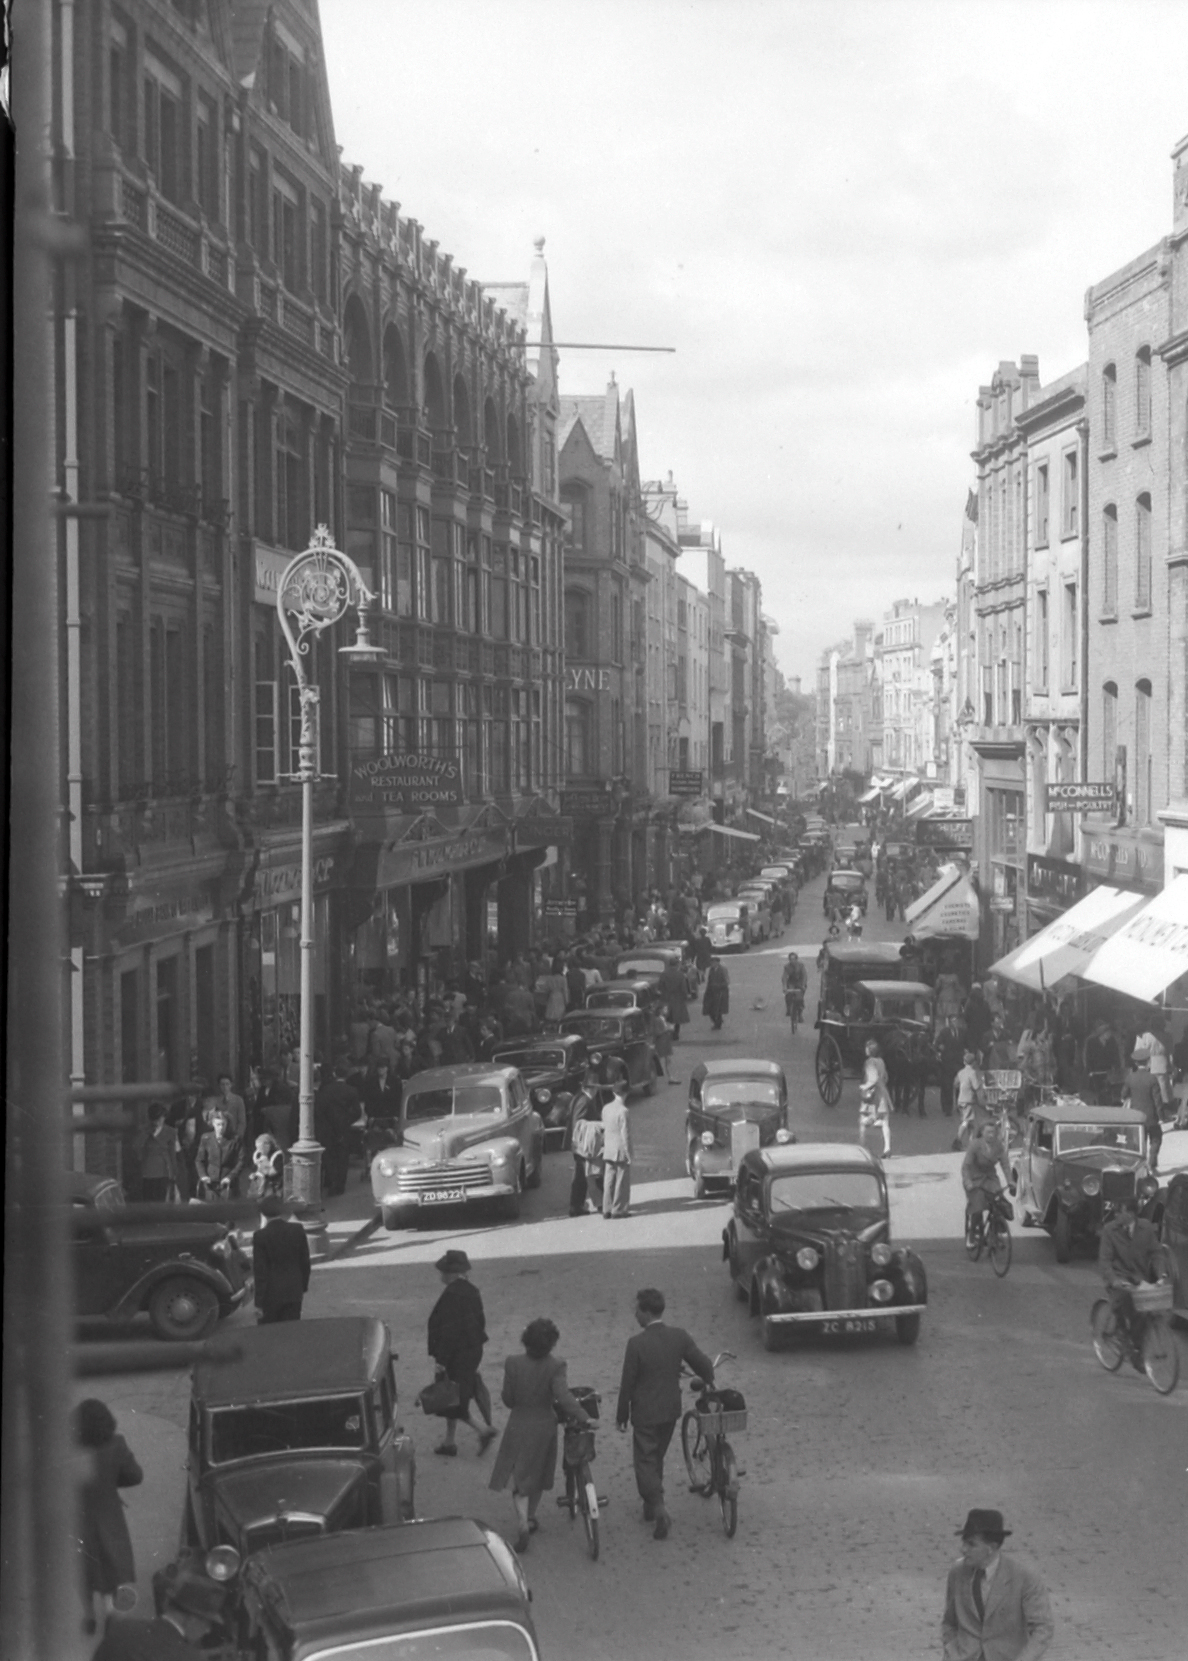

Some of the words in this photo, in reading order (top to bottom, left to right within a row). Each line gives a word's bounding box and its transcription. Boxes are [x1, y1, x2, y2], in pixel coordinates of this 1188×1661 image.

[354, 754, 458, 779] WOOLWORTH'S
[371, 775, 439, 786] RESTAURANT
[382, 791, 404, 801] TEA
[412, 790, 458, 801] ROOMS
